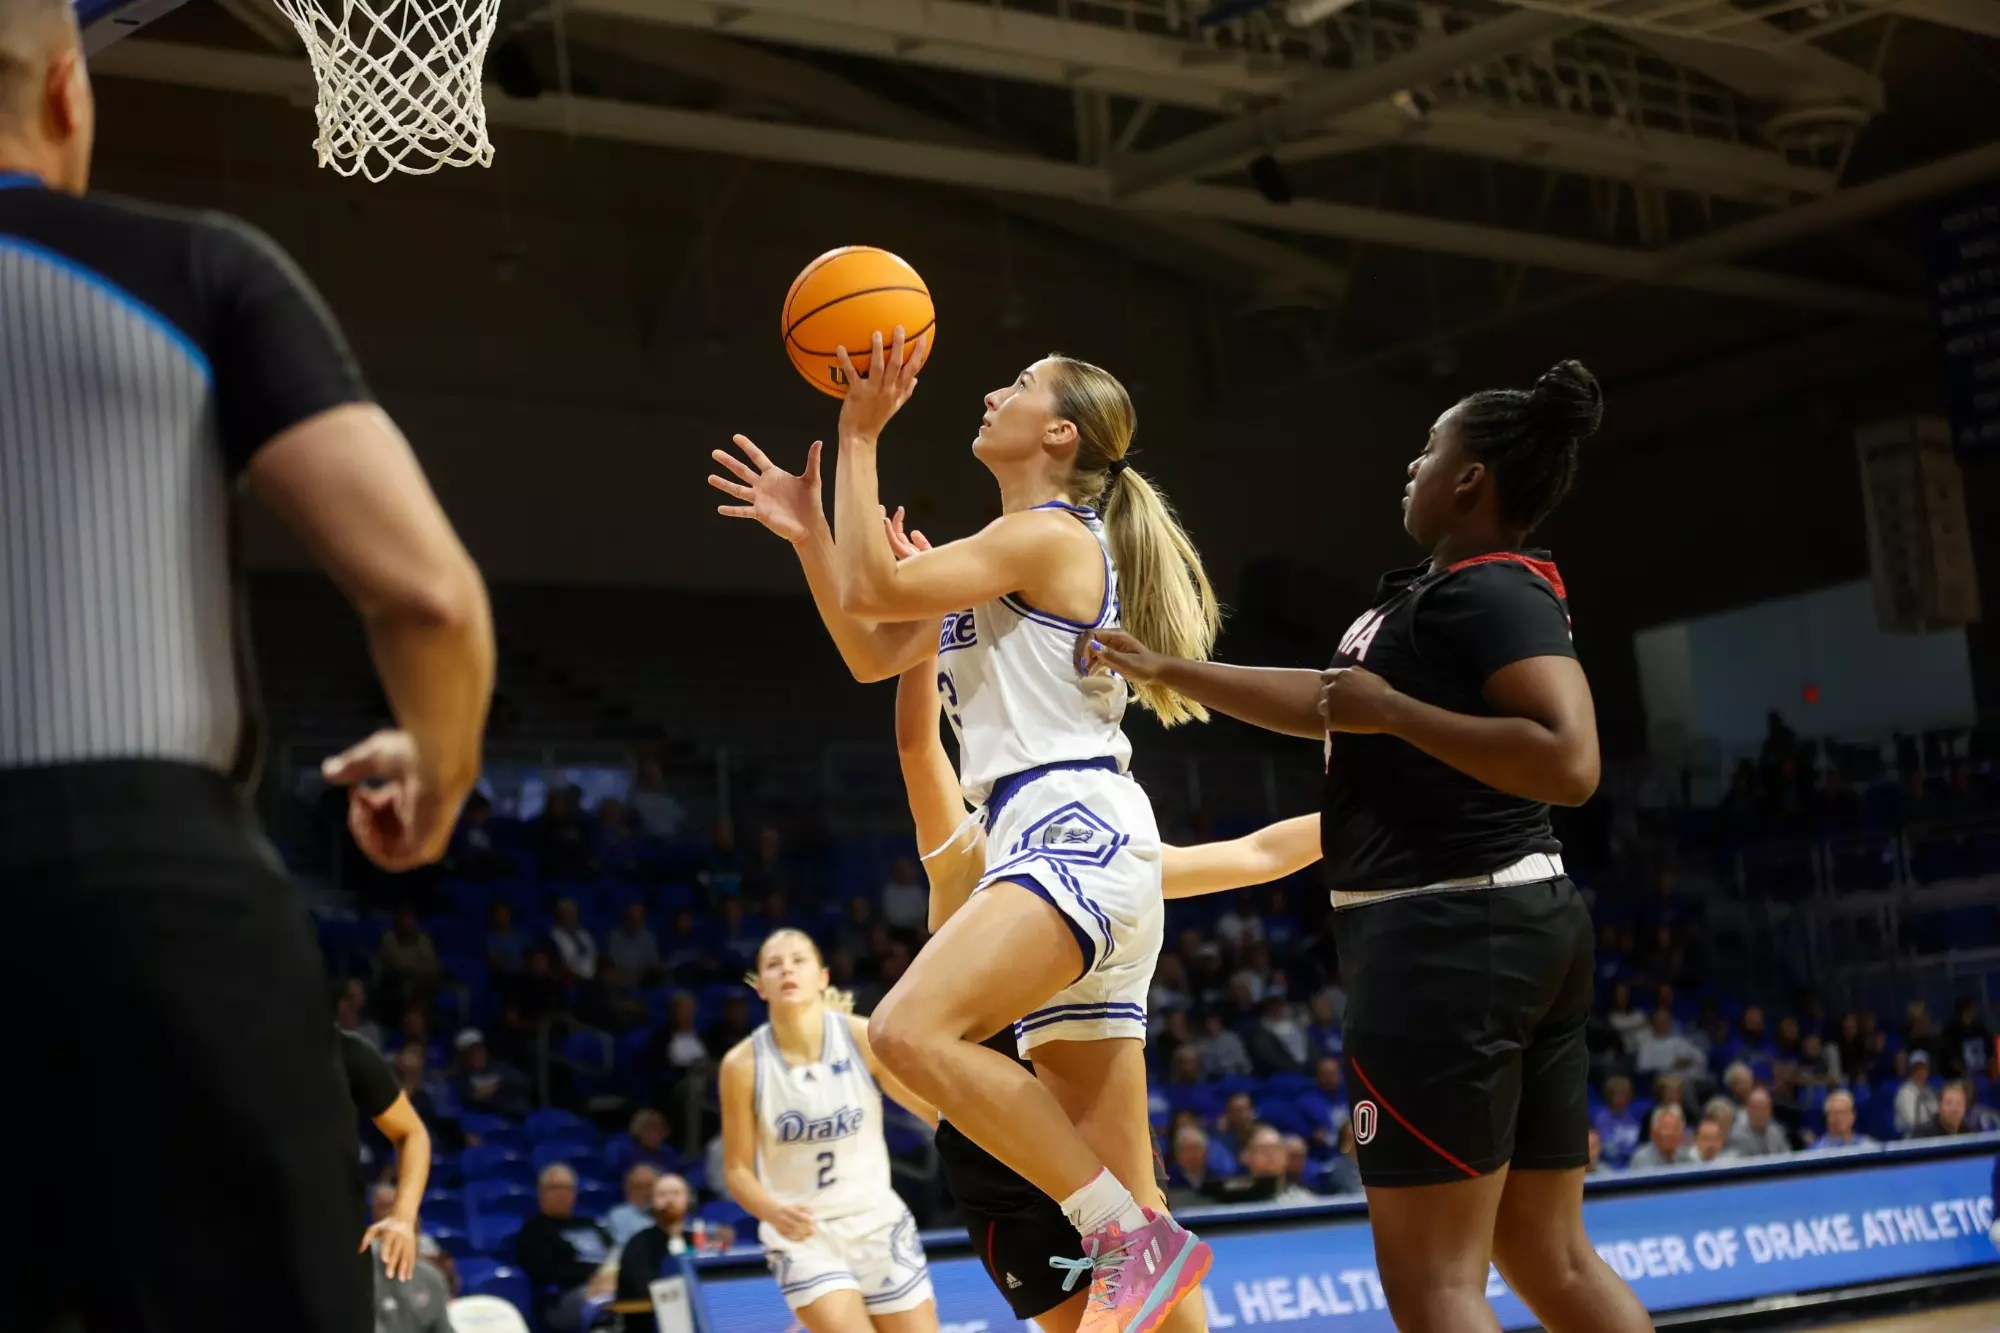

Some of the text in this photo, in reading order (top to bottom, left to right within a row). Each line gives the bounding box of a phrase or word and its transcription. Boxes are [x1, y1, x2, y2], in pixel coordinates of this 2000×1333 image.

[775, 1105, 863, 1144] Drake
[816, 1151, 837, 1189] 2
[1693, 1226, 1739, 1271] OF
[1744, 1213, 1859, 1264] DRAKE
